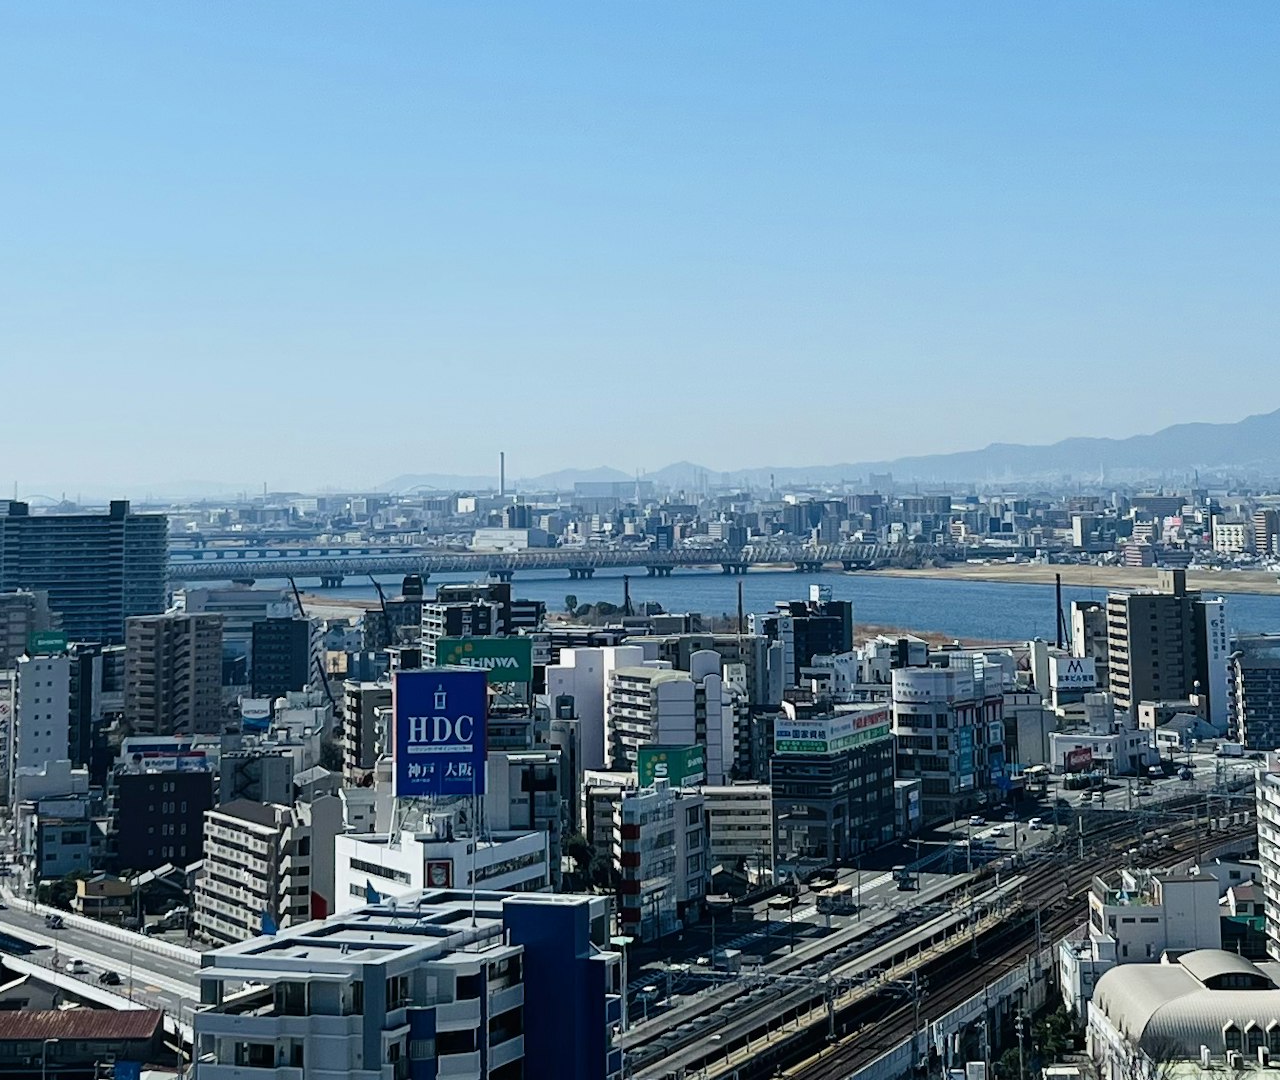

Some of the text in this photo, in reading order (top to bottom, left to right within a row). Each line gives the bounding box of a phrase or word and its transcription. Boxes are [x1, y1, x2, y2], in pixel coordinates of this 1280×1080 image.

[407, 715, 473, 743] HDC
[407, 762, 435, 778] 神戸
[445, 762, 473, 777] 大阪
[655, 763, 668, 777] S
